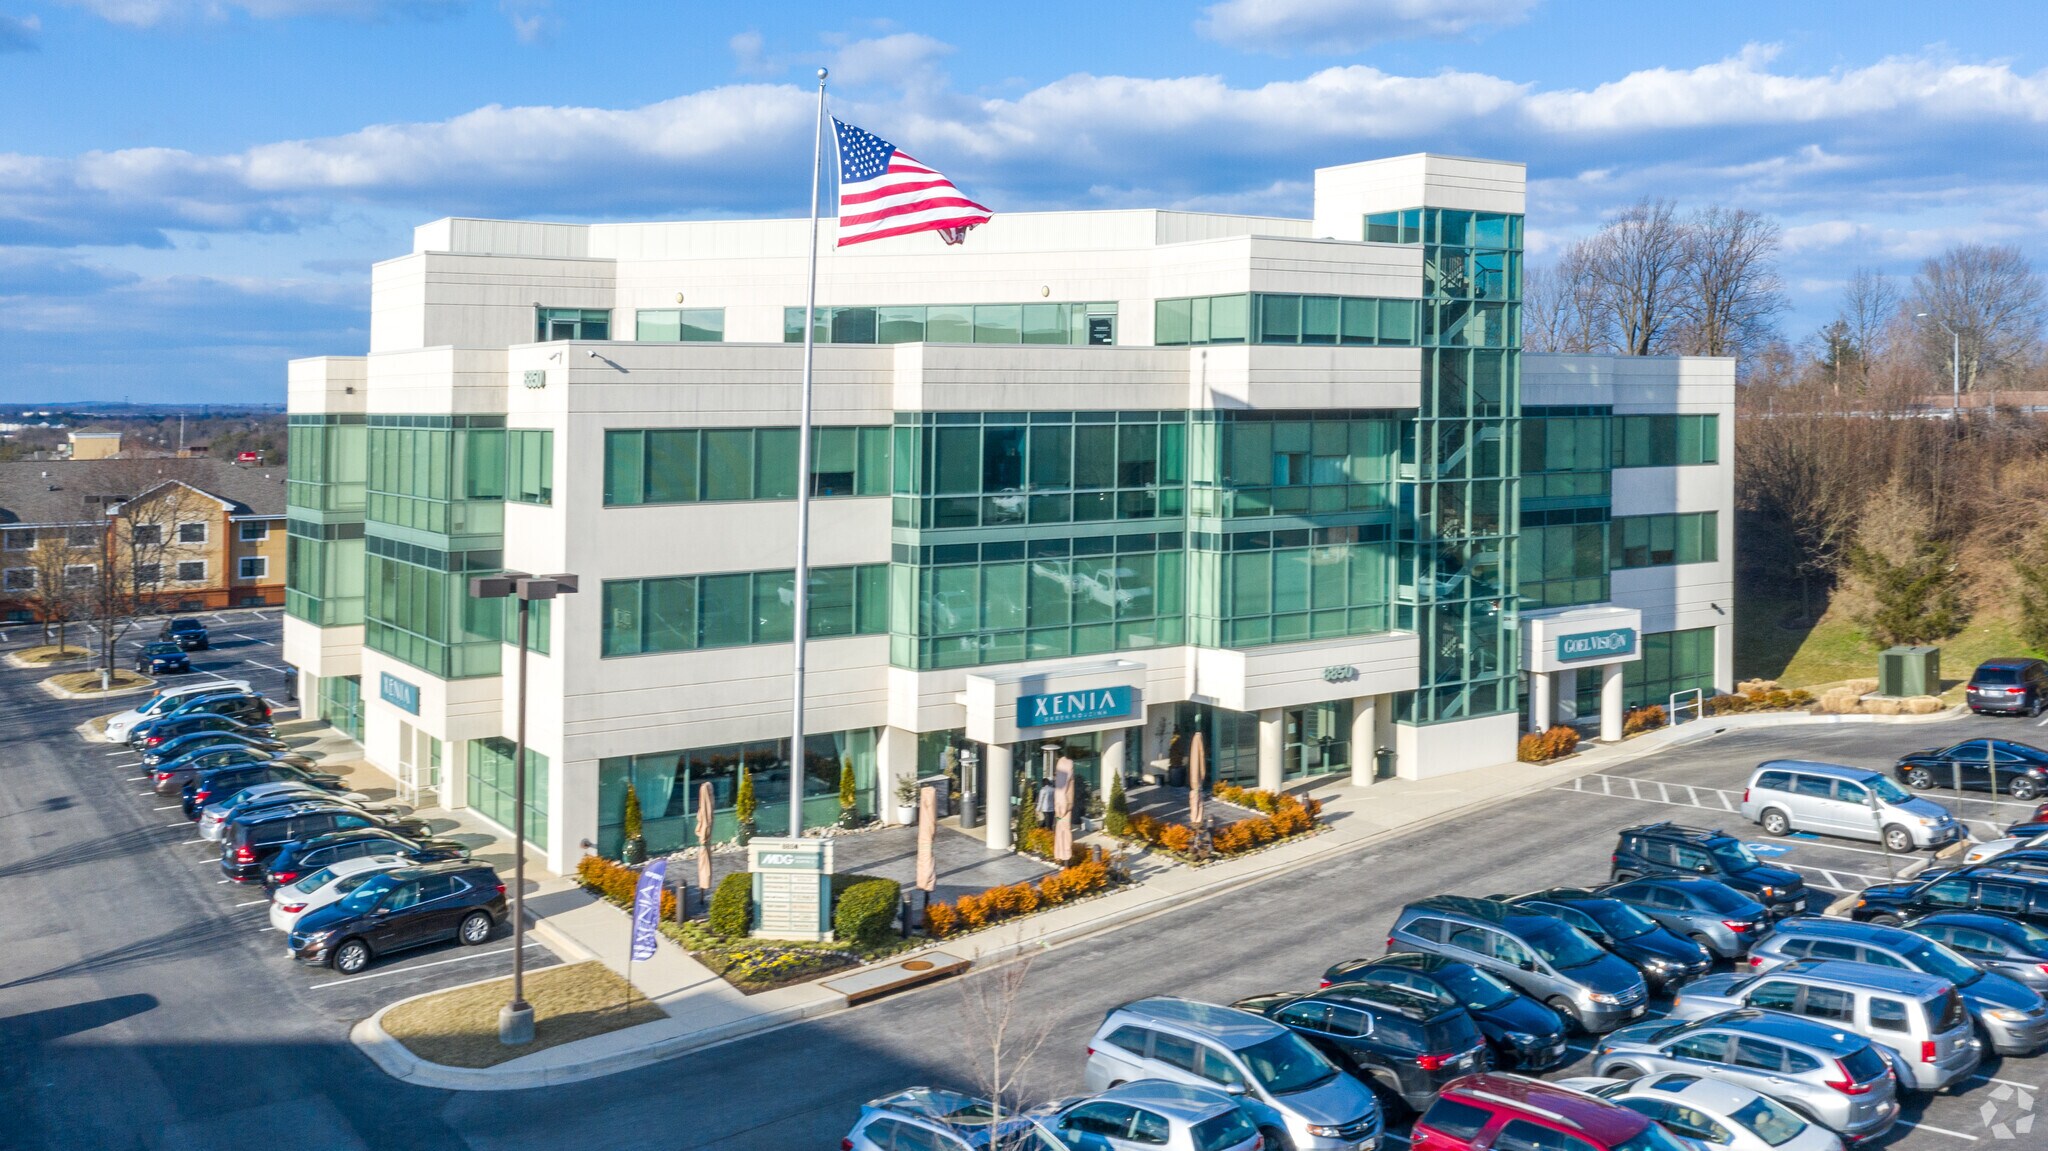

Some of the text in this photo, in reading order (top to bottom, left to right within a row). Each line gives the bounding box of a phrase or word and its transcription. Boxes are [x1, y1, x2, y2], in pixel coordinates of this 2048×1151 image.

[1564, 632, 1626, 653] GOEL VISION
[1322, 665, 1353, 680] 8850
[1035, 690, 1116, 716] XENIA
[761, 853, 794, 865] MDG
